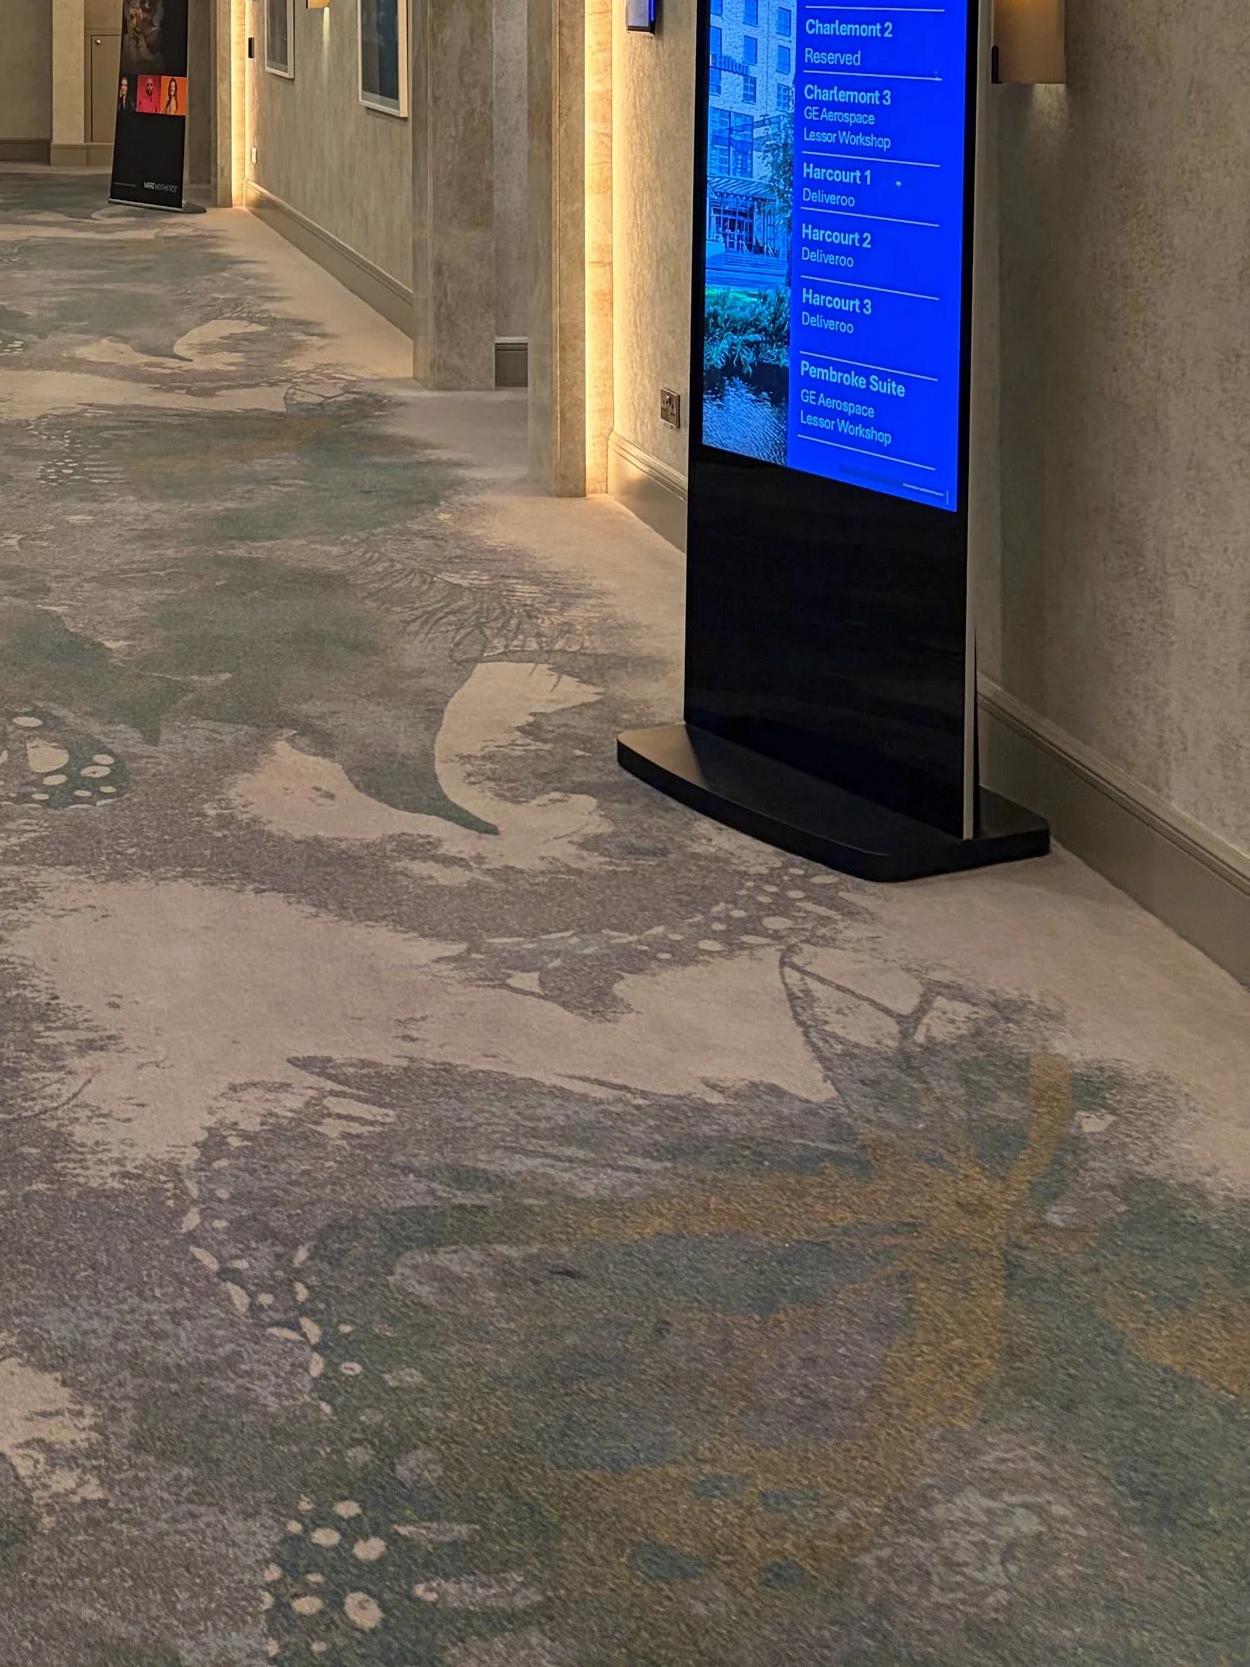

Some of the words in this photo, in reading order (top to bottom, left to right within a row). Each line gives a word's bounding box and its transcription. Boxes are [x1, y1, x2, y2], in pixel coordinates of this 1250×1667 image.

[805, 19, 881, 37] Charlemont
[884, 22, 893, 38] 2
[805, 47, 861, 66] Reserved
[804, 84, 880, 105] Charlemont
[882, 90, 891, 105] 3
[804, 106, 819, 120] GE
[820, 107, 875, 126] Aerospace
[804, 127, 837, 143] Lessor
[838, 130, 891, 152] Workshop
[803, 162, 861, 184] Harcourt
[864, 170, 871, 185] 1
[802, 188, 855, 208] Deliveroo
[802, 223, 860, 246] Harcourt
[862, 232, 871, 248] 2
[802, 247, 854, 267] Deliveroo
[802, 288, 860, 313] Harcourt
[863, 299, 872, 315] 3
[802, 311, 854, 334] Deliveroo
[801, 360, 866, 389] Pembroke
[869, 375, 905, 397] Suite
[800, 389, 816, 405] GE
[817, 393, 875, 418] Aerospace
[800, 410, 835, 430] Lessor
[836, 417, 892, 447] Workshop
